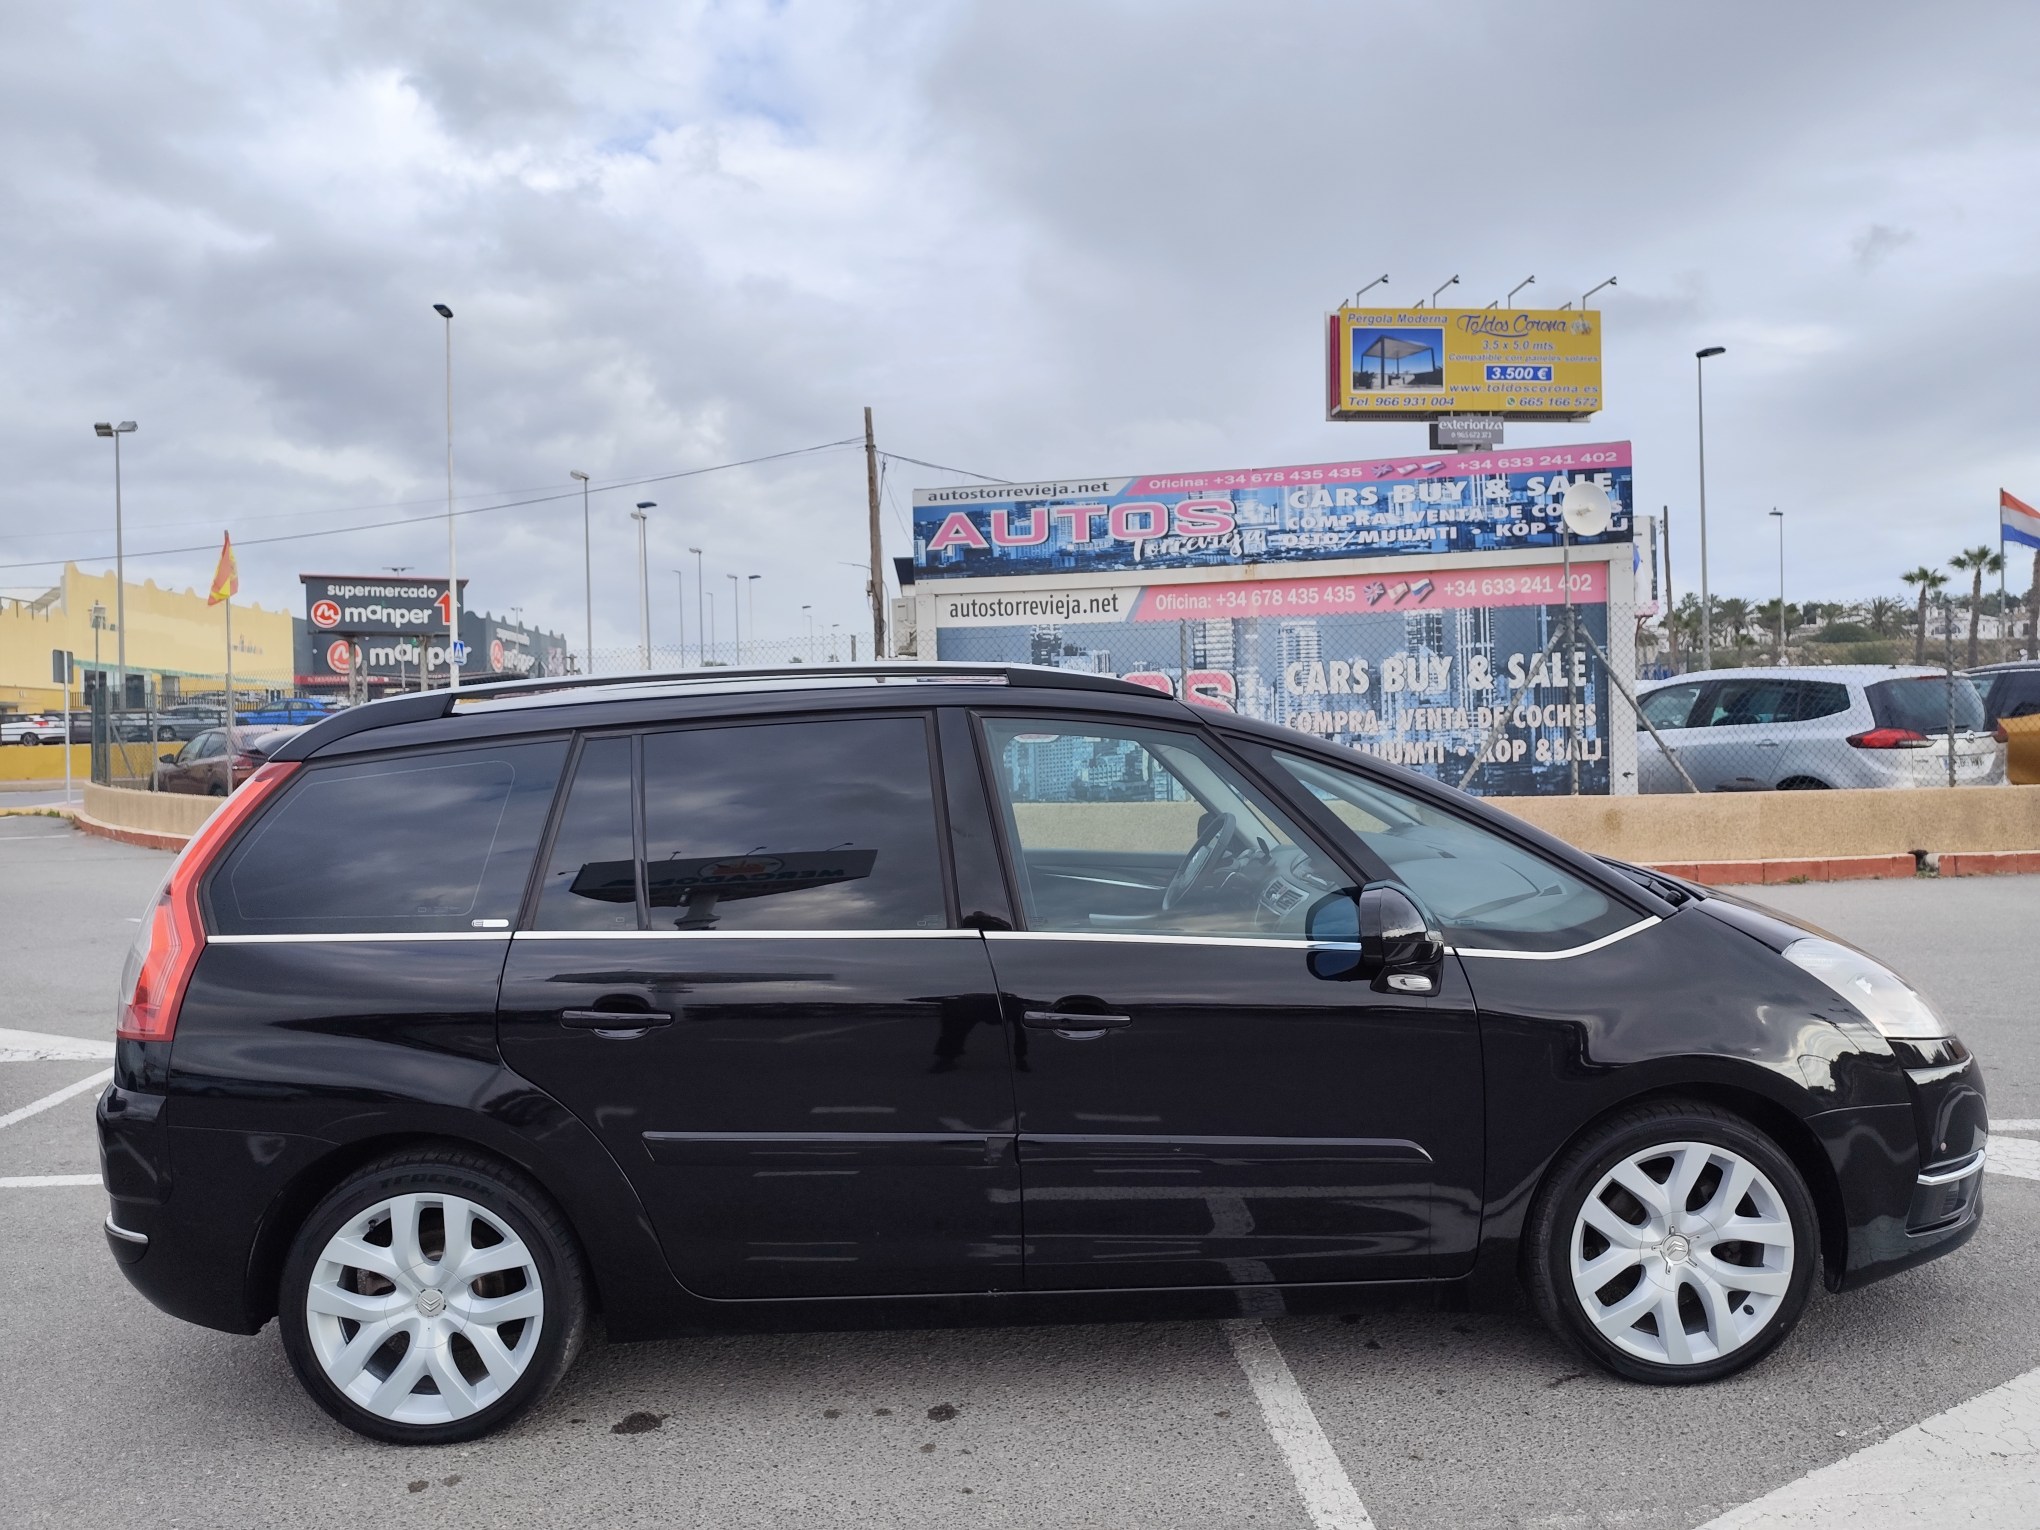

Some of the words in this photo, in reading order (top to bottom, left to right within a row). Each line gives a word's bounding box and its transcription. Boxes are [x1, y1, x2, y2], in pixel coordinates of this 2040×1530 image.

[1397, 313, 1448, 323] Moderna
[1513, 314, 1567, 333] Corona
[1449, 353, 1502, 363] Compatible
[1491, 367, 1534, 380] 3.500
[1537, 368, 1549, 380] €
[1375, 397, 1399, 406] 966
[1403, 397, 1426, 406] 931
[1430, 397, 1454, 406] 004
[1519, 397, 1543, 406] 665
[1549, 397, 1570, 406] 166
[1574, 397, 1598, 406] 572
[1438, 419, 1503, 430] exterioriza
[1457, 459, 1492, 470] +34
[1497, 456, 1534, 468] 633
[1539, 454, 1575, 465] 241
[1580, 452, 1617, 463] 402
[1149, 478, 1208, 490] Oficina:
[1213, 474, 1249, 485] +34
[1251, 472, 1285, 483] 678
[1289, 470, 1323, 481] 435
[1327, 467, 1363, 478] 435
[928, 481, 1110, 502] autostorrevieja.net
[1288, 486, 1379, 509] CARS
[1393, 480, 1468, 504] BUY
[1484, 479, 1511, 498] &
[926, 499, 1238, 551] AUTOS
[1287, 512, 1388, 529] COMPRA
[1406, 508, 1484, 524] VENTA
[1492, 505, 1523, 519] DE
[1532, 500, 1623, 517] COS
[1496, 519, 1546, 537] KÖP
[1130, 528, 1266, 562] Torrevieja
[326, 584, 437, 599] supermercado
[1444, 579, 1477, 596] +34
[1481, 577, 1516, 595] 633
[1520, 575, 1553, 593] 241
[1557, 573, 1592, 592] 402
[949, 593, 1119, 620] autostorrevieja.net
[1155, 592, 1212, 610] Oficina:
[1216, 591, 1248, 608] +34
[1251, 588, 1283, 606] 678
[1287, 587, 1320, 605] 435
[1323, 585, 1356, 603] 435
[344, 604, 433, 628] manper
[1285, 658, 1370, 695] CARS
[1382, 655, 1453, 692] BUY
[1467, 654, 1495, 690] &
[1507, 651, 1587, 689] SALE
[1286, 709, 1380, 735] COMPRA
[1400, 706, 1470, 731] VENTA
[1513, 703, 1597, 729] COCHES
